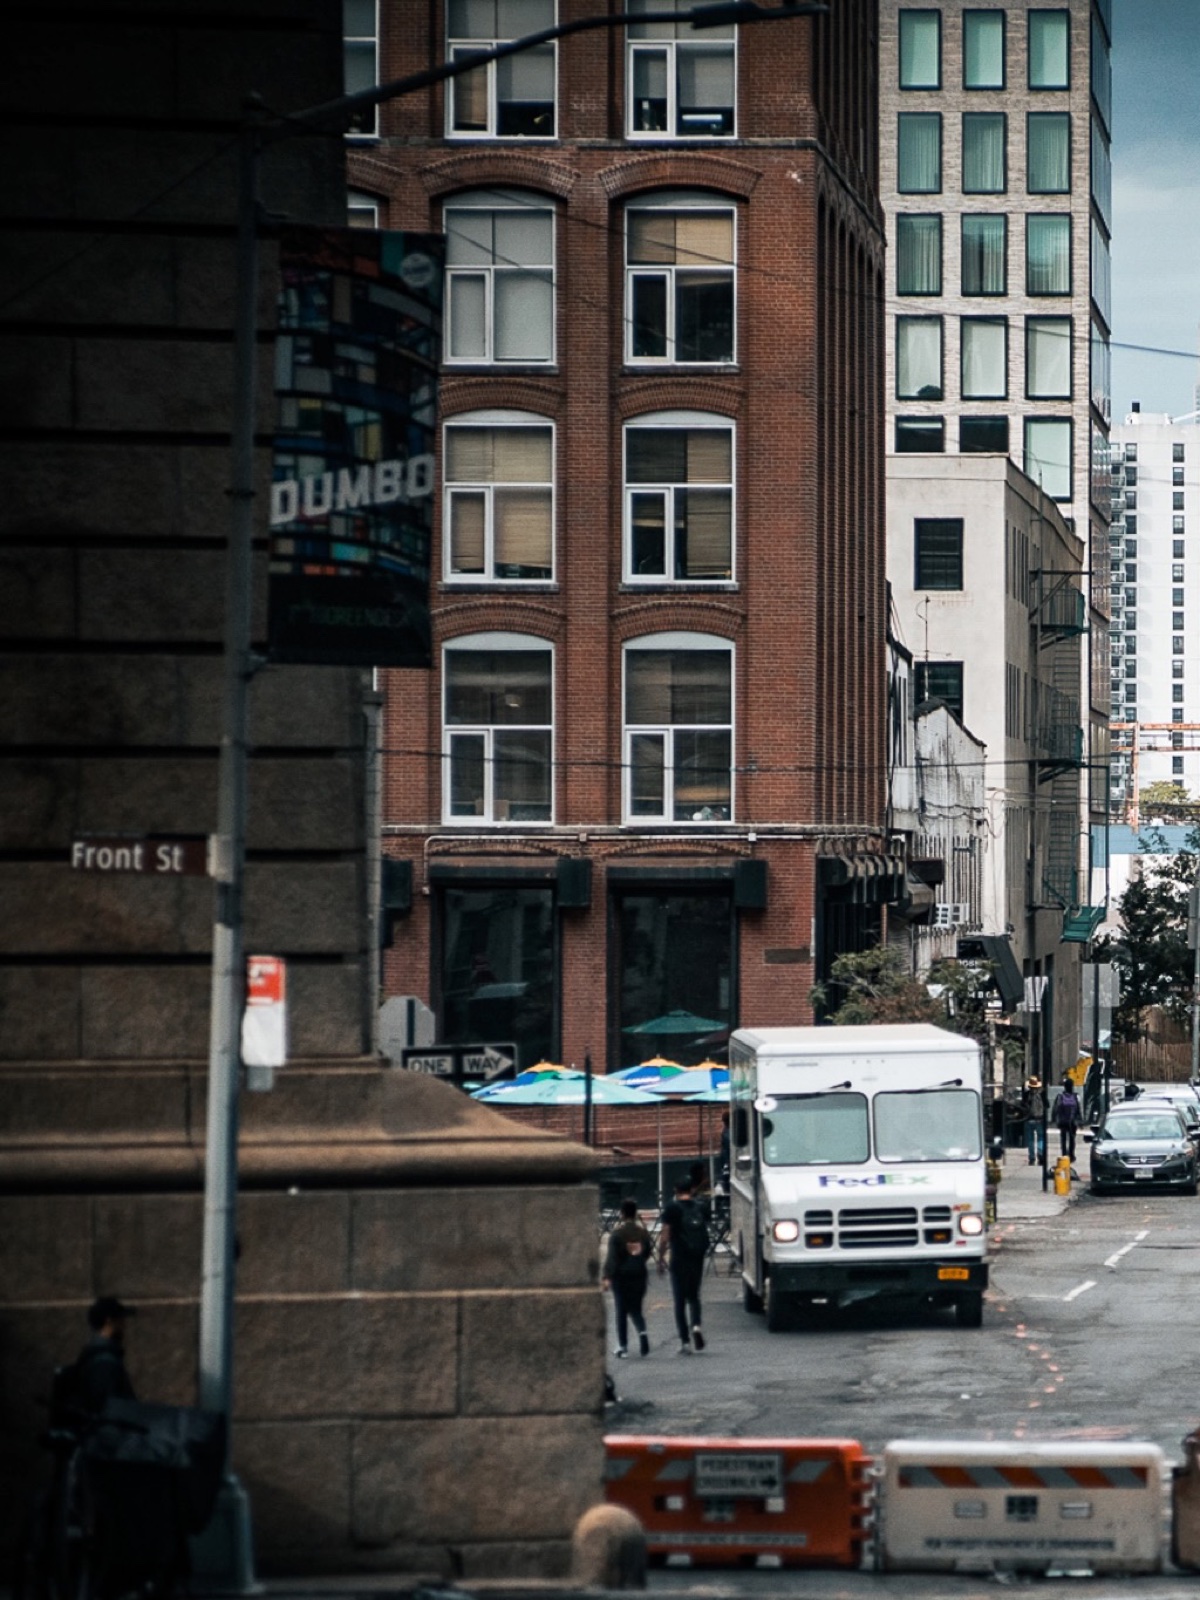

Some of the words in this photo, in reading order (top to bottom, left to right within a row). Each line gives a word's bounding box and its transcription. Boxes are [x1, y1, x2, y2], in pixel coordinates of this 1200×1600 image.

[270, 453, 435, 525] DUMBO
[72, 842, 143, 870] Front
[157, 844, 184, 871] St
[410, 1059, 447, 1073] ONE
[467, 1057, 501, 1071] WAY
[819, 1174, 931, 1188] FedEx
